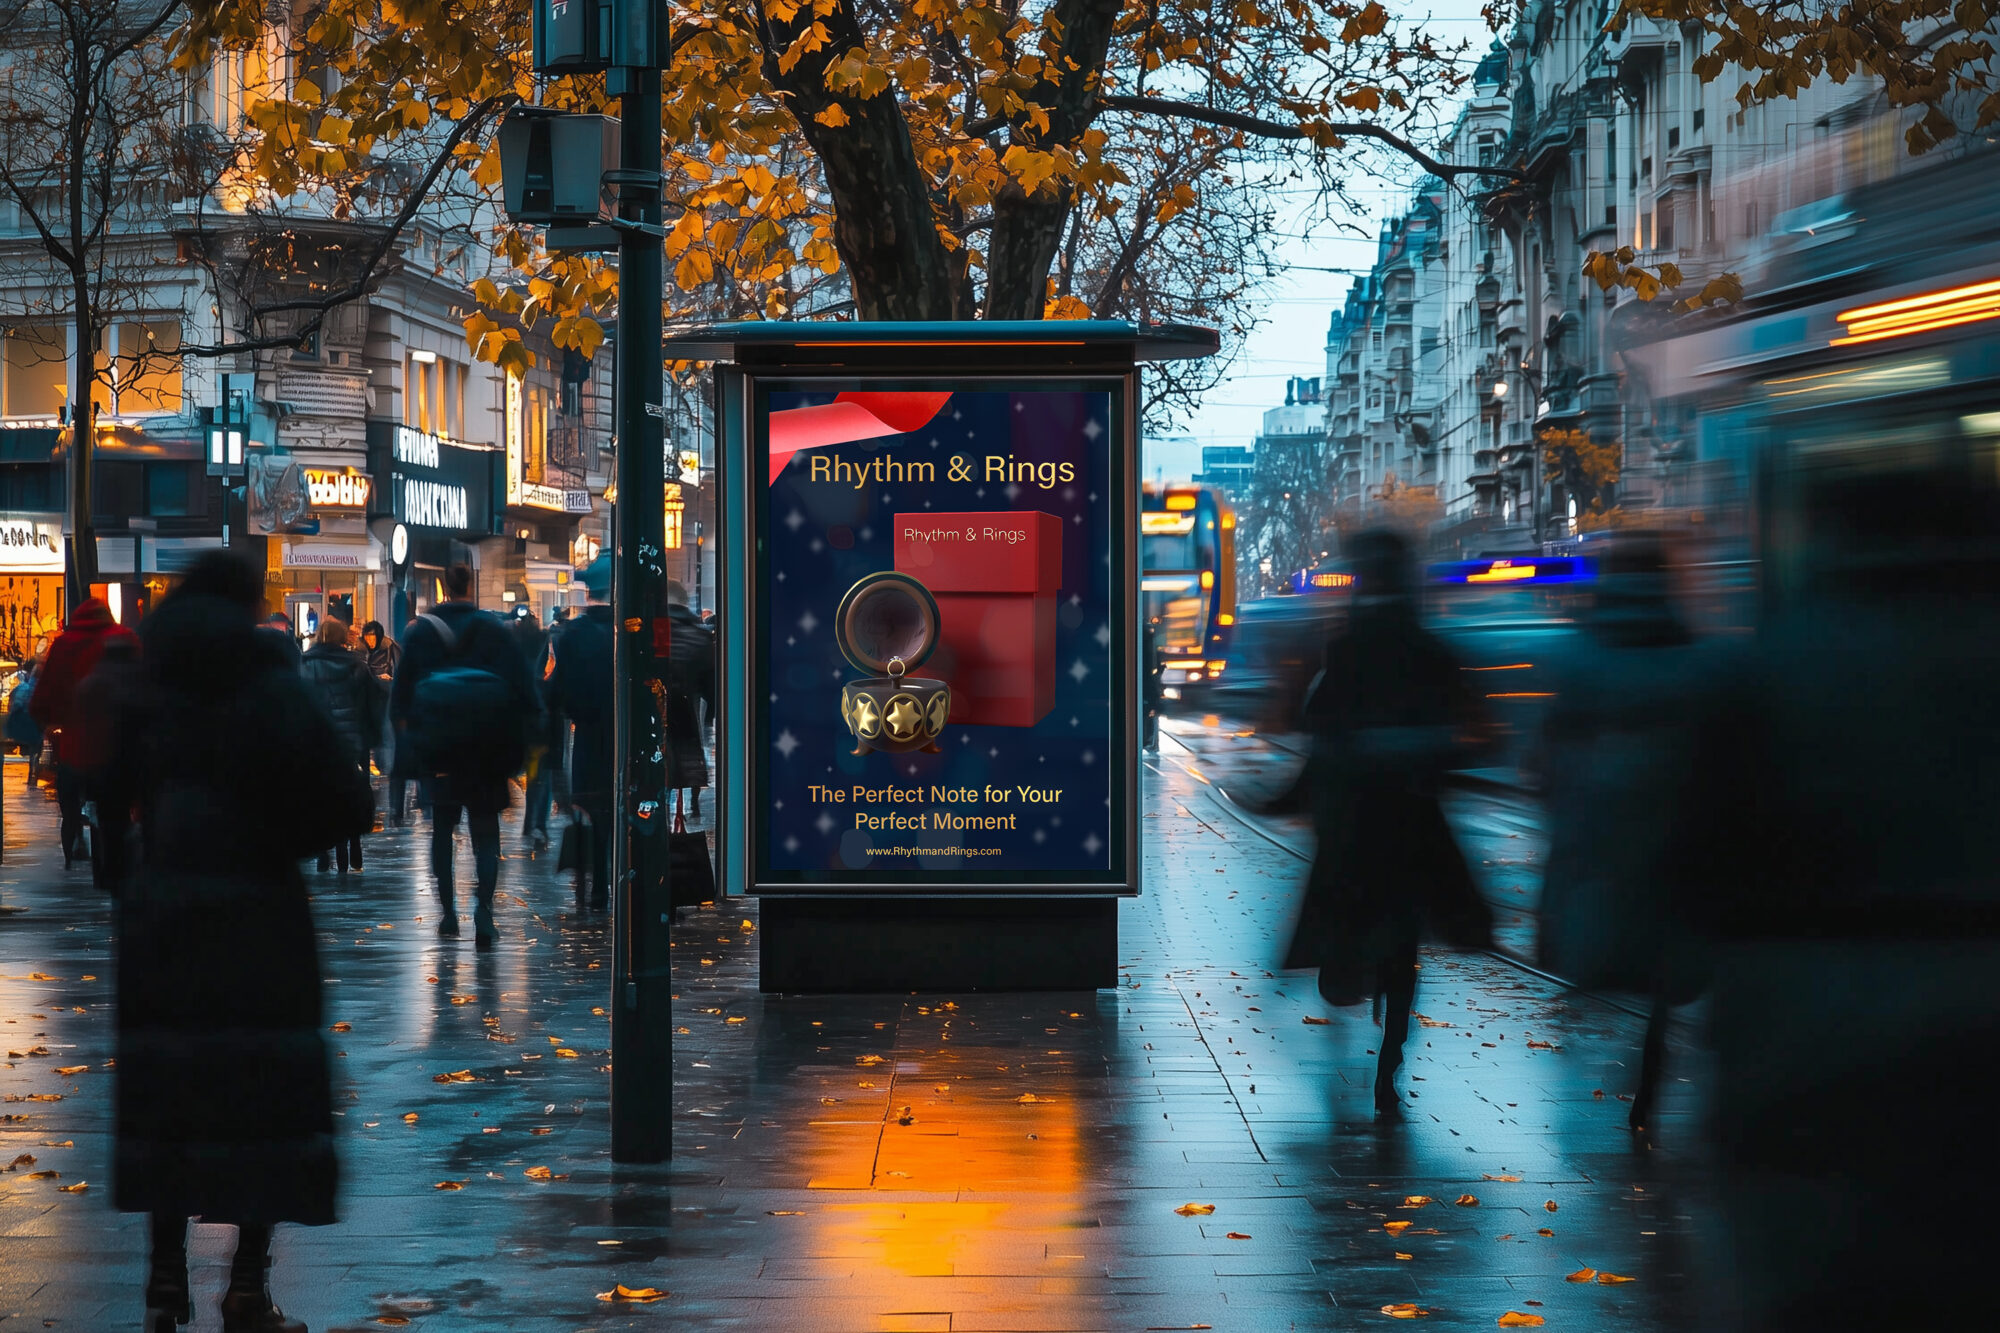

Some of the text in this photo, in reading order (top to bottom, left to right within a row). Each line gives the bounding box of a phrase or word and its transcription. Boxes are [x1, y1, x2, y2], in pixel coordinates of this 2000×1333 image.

[811, 453, 1075, 490] Rhythm & Rings
[904, 527, 1027, 545] Rhythm & Rings
[807, 785, 1063, 803] The Perfect Note for Your
[855, 811, 1017, 830] Perfect Moment
[865, 846, 1002, 858] www.RhythmandRings.com
